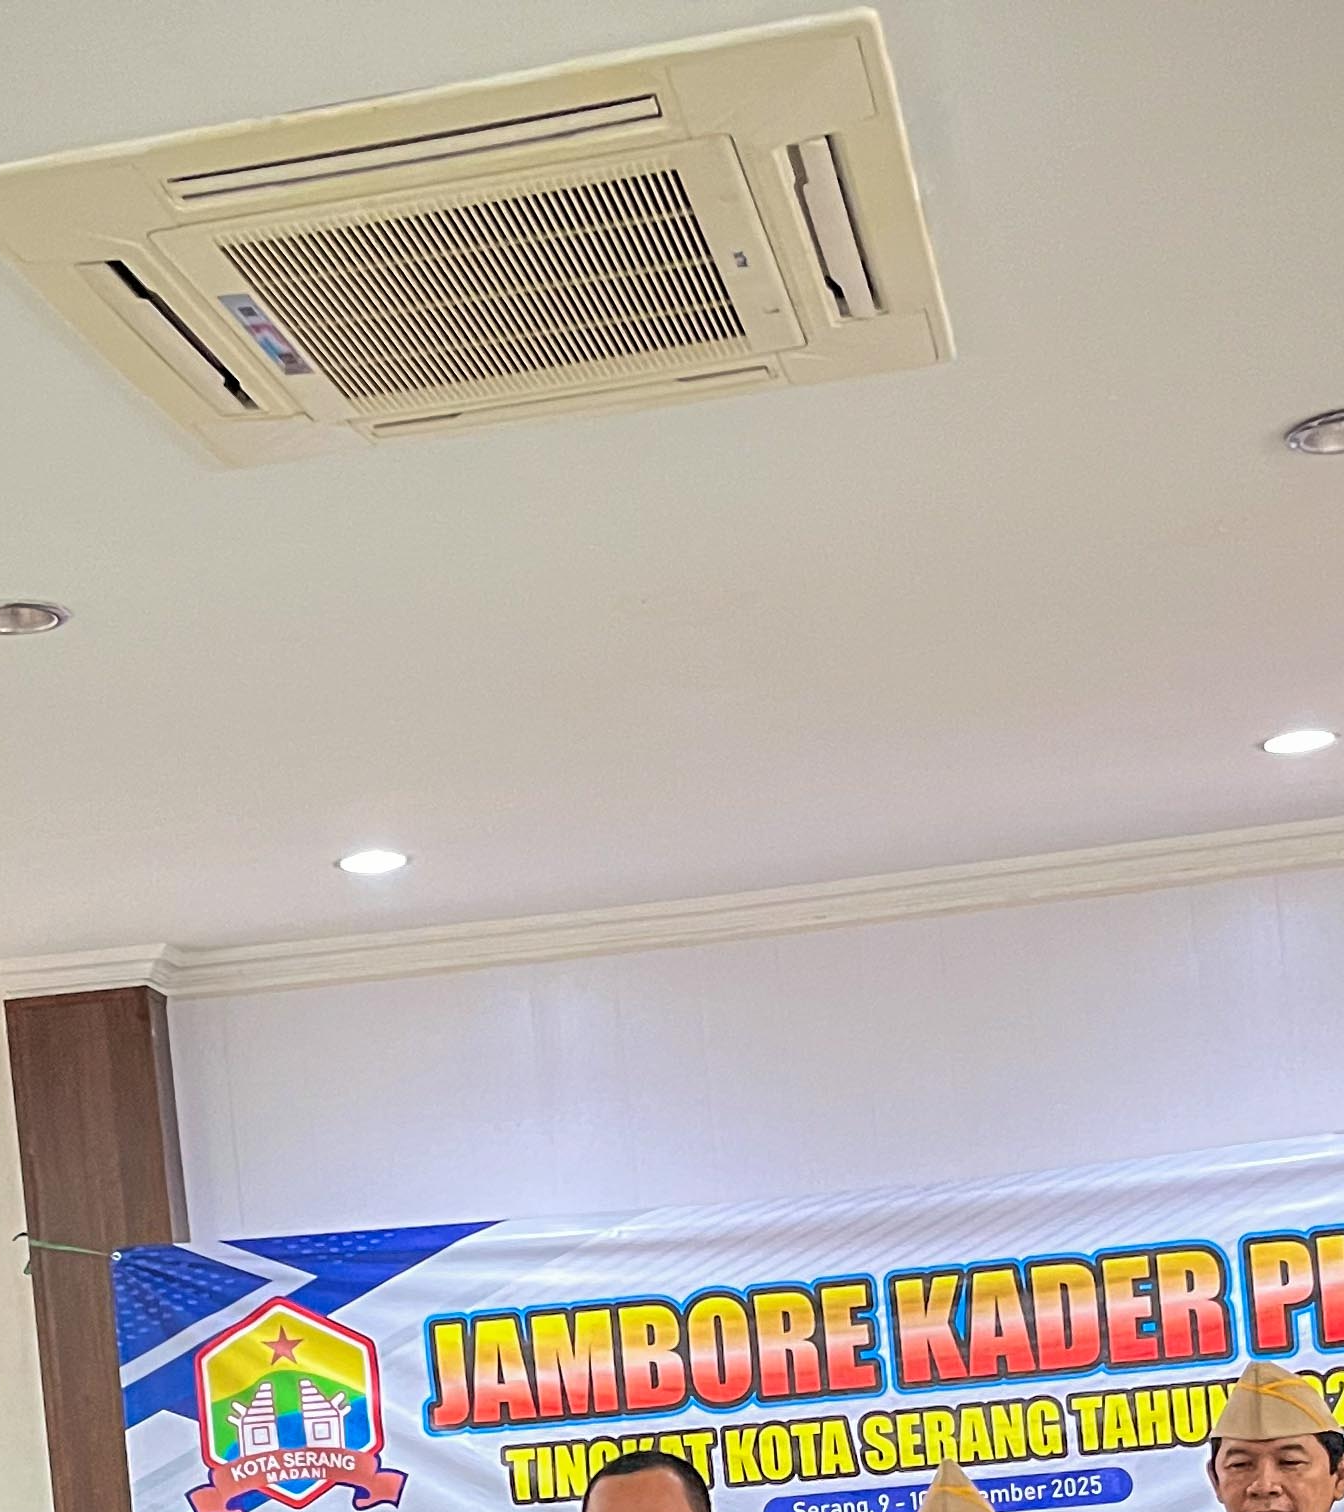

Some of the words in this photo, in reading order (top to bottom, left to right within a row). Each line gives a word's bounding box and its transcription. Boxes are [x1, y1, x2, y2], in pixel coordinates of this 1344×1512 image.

[429, 1278, 880, 1431] JAMBORE
[889, 1245, 1234, 1387] KADER
[725, 1417, 854, 1485] KOTA
[862, 1398, 1063, 1472] SERANG
[231, 1456, 281, 1481] KOTA
[283, 1451, 356, 1471] SERANG
[266, 1467, 327, 1483] MADANI
[1052, 1475, 1102, 1499] 2025
